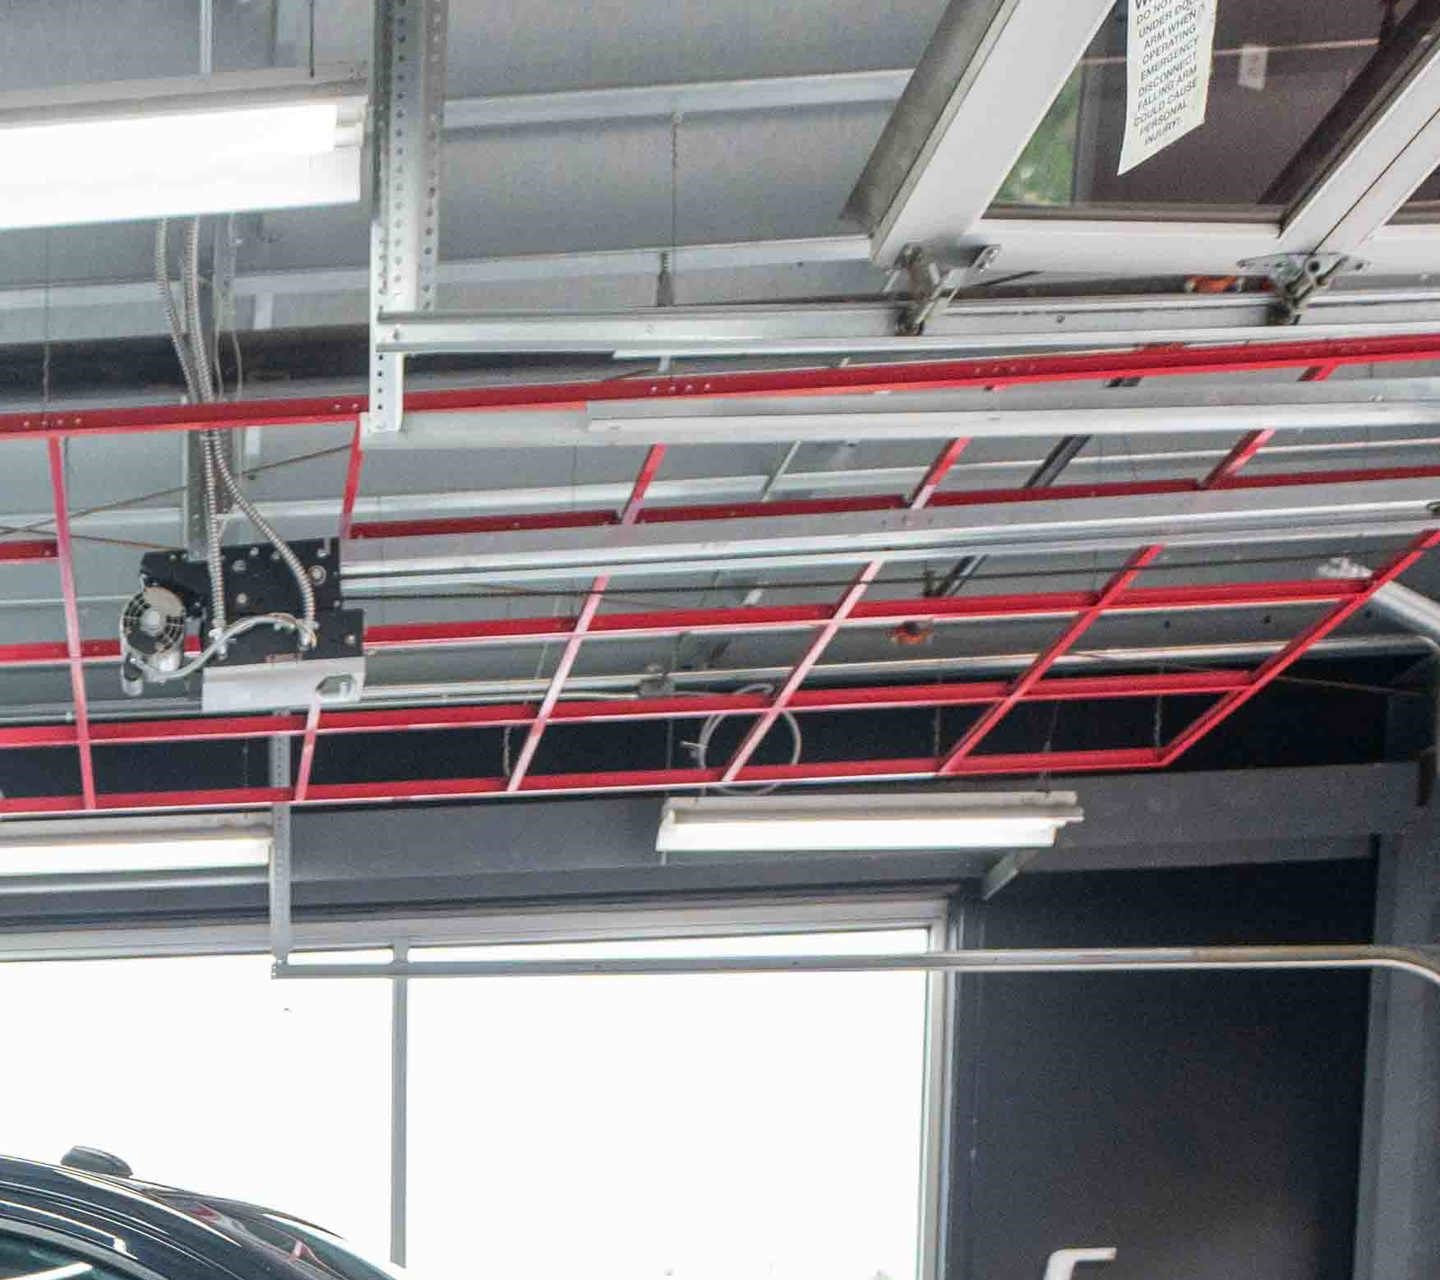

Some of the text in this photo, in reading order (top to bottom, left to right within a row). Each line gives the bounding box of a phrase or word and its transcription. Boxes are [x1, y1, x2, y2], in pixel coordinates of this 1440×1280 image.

[1167, 9, 1197, 34] WHEN
[1140, 35, 1199, 82] EMERGENCY
[1142, 24, 1197, 65] OPERATING
